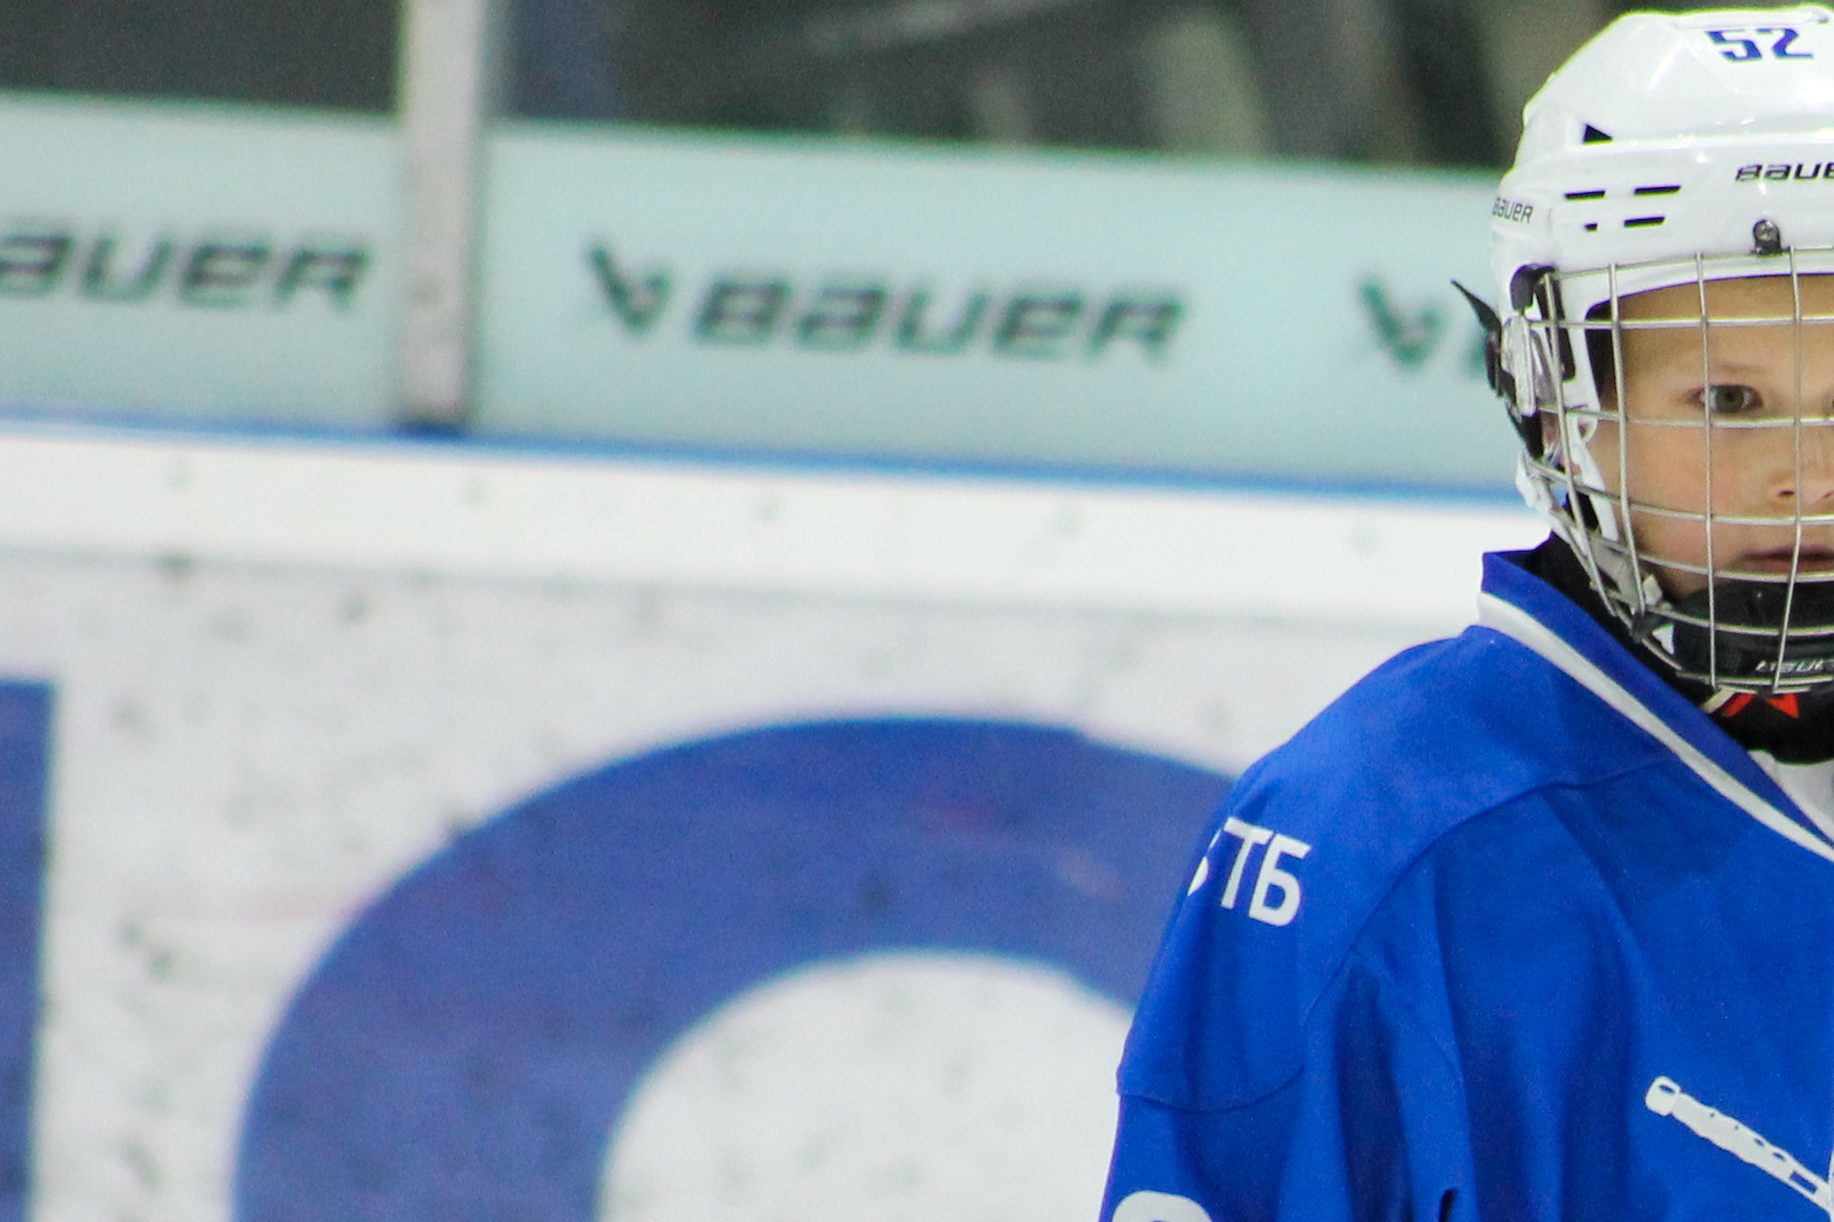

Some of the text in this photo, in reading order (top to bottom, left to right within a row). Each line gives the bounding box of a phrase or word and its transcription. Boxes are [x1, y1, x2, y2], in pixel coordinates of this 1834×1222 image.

[1704, 27, 1814, 63] 52
[696, 276, 1188, 364] BAUER
[1187, 816, 1311, 927] ТБ
